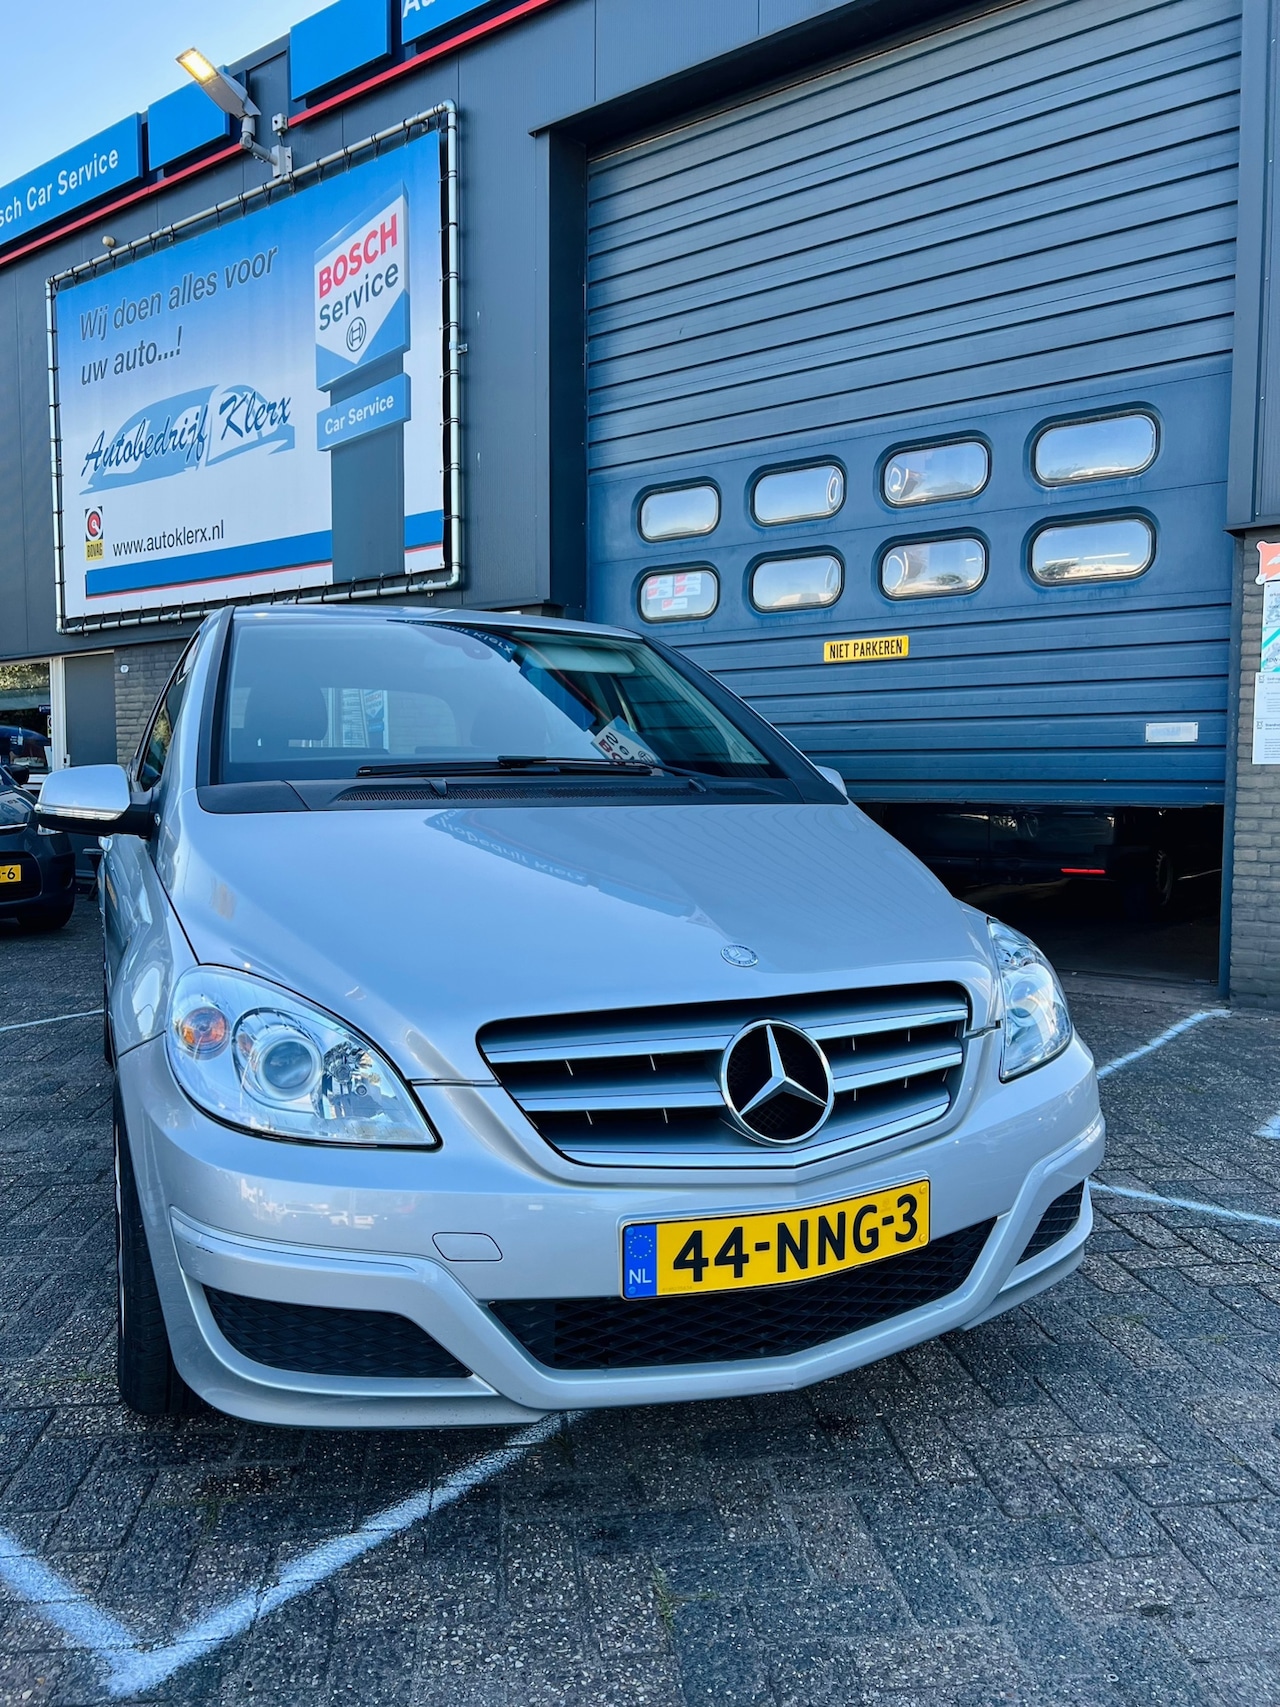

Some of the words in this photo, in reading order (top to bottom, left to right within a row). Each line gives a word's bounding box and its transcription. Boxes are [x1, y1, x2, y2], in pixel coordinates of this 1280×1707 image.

[27, 186, 53, 212] Car
[58, 149, 119, 196] Service
[318, 213, 398, 299] BOSCH
[79, 309, 107, 342] Wij
[112, 290, 162, 327] doen
[169, 272, 217, 310] alles
[224, 245, 279, 289] voor
[318, 262, 399, 331] Service
[81, 357, 108, 385] uw
[114, 325, 183, 375] auto...!
[80, 402, 209, 477] Autobedrijf
[218, 392, 293, 441] Klerx
[324, 413, 346, 436] Car
[348, 394, 395, 425] Service
[87, 542, 103, 558] BOVAG
[112, 519, 226, 557] www.autoklerx.nl
[829, 643, 850, 660] NIET
[853, 638, 903, 658] PARKEREN
[628, 1268, 652, 1285] NL
[672, 1193, 919, 1283] 44-NNG-3
